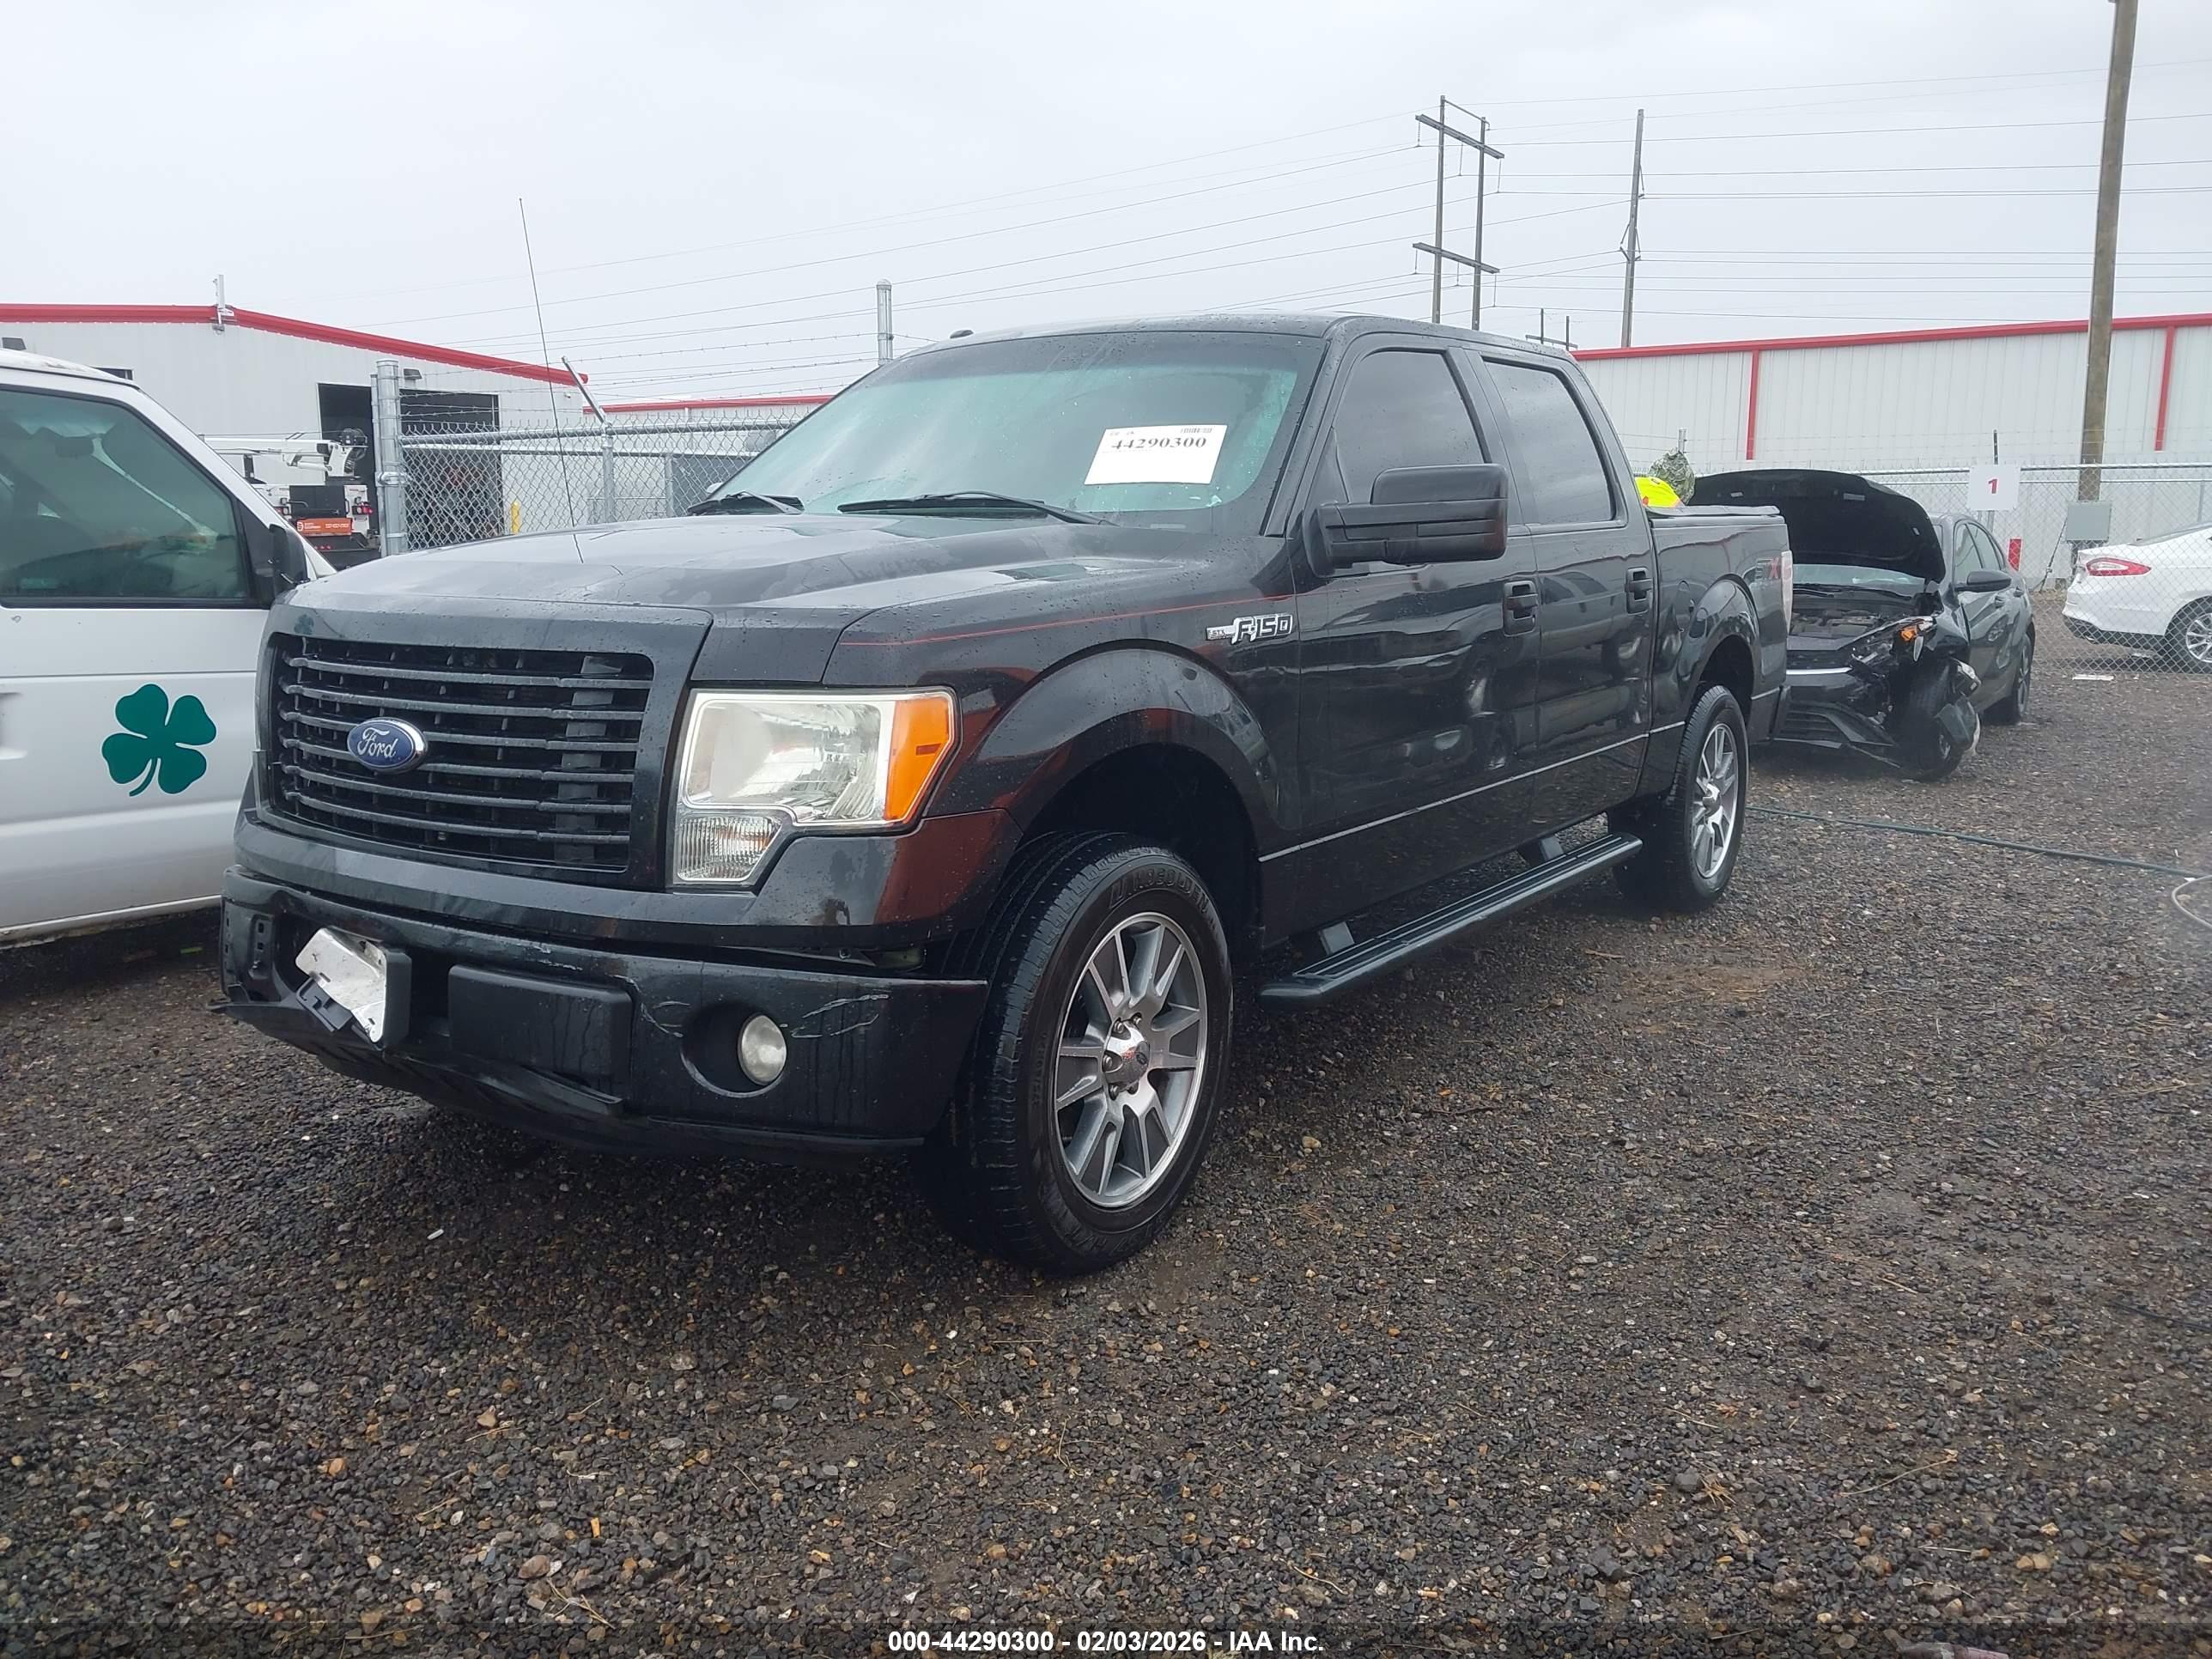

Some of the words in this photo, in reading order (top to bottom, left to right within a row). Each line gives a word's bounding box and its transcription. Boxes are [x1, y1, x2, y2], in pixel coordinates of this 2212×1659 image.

[1111, 436, 1207, 450] 44290300
[1987, 477, 1998, 495] 1
[357, 726, 398, 758] Ford
